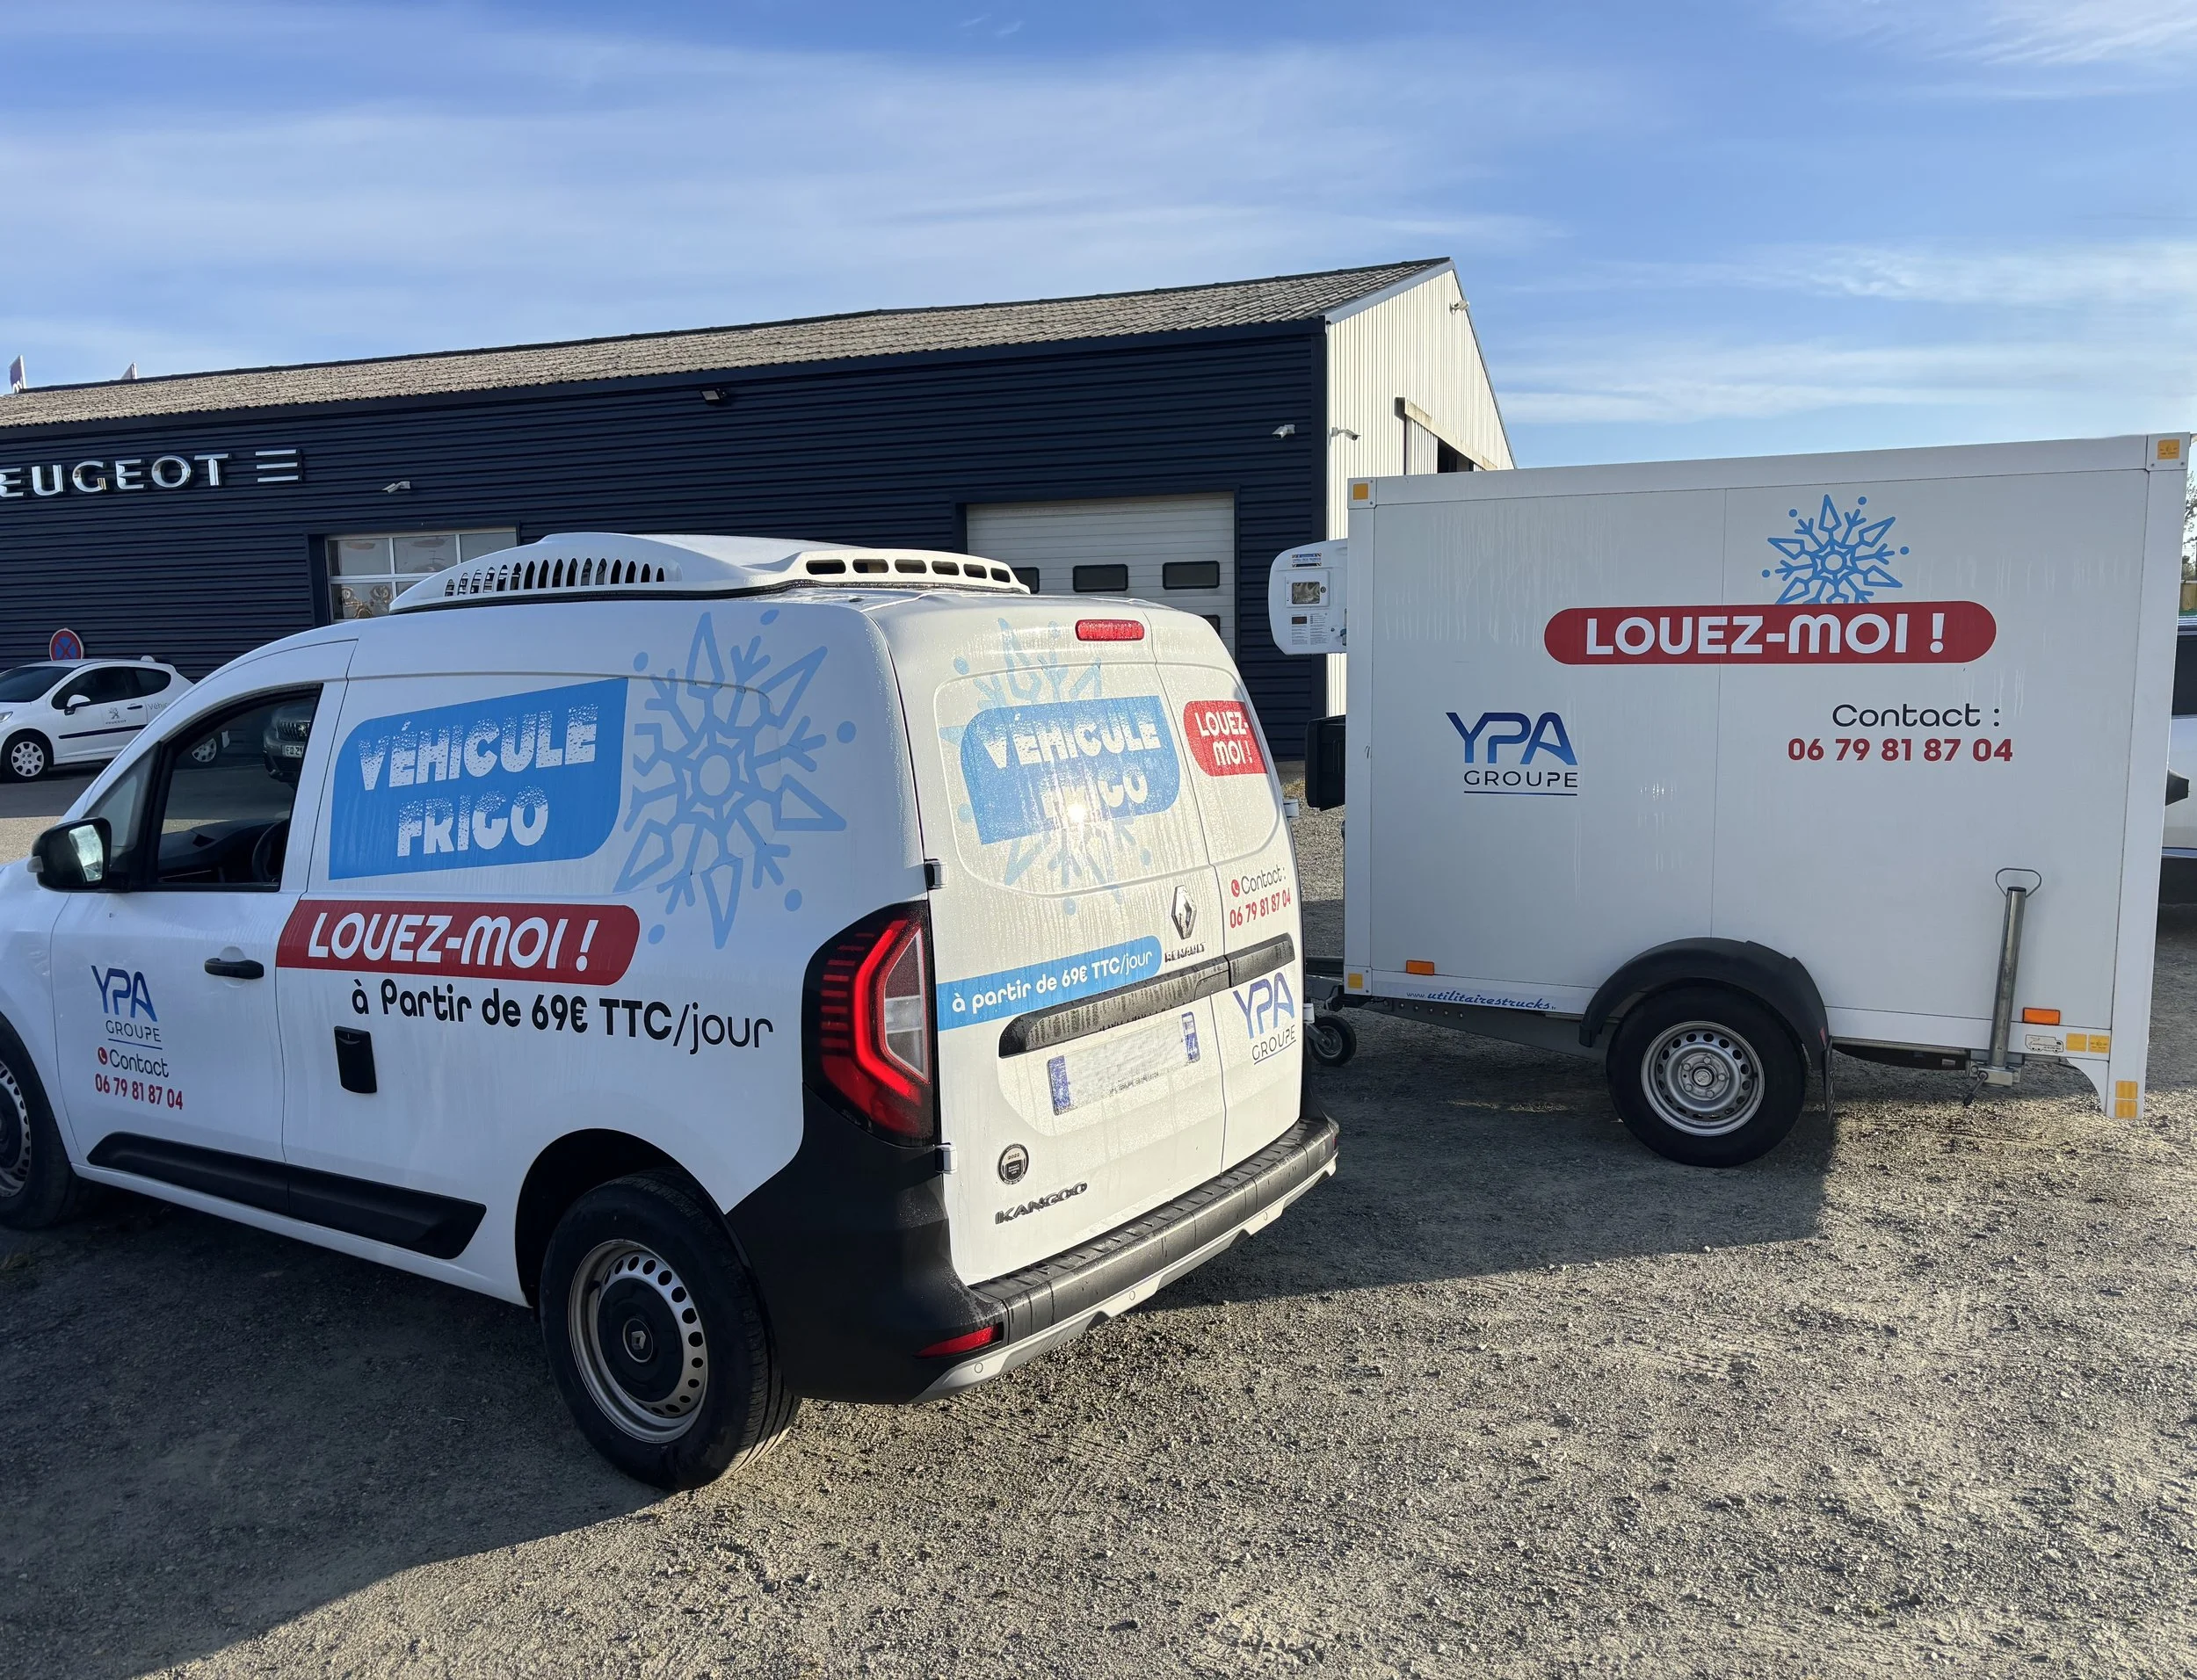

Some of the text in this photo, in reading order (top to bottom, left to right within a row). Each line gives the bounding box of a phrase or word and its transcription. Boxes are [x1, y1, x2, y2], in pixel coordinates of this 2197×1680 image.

[0, 453, 230, 498] EUGEOT
[1585, 612, 1945, 655] LOUEZ-MOI !
[1194, 711, 1249, 737] LOUEZ-
[1832, 703, 1981, 728] Contact
[358, 704, 598, 791] VÉHICULE
[981, 711, 1162, 770] VÉHICULE
[1213, 739, 1246, 765] MOI
[1446, 712, 1578, 765] YPA
[1787, 738, 2013, 762] 06 79 81 87 04
[1464, 771, 1577, 788] GROUPE
[397, 786, 548, 857] FRIGO
[1241, 865, 1282, 894] Contact
[1229, 887, 1291, 929] 06 79 81 87 04
[308, 912, 599, 972] LOUEZ-MOI !
[91, 965, 157, 1022] YPA
[952, 950, 1153, 1014] à partir de 69€ TTC/jour
[352, 978, 774, 1055] à Partir de 69€ TTC/jour
[1232, 972, 1295, 1039] YPA
[105, 1019, 161, 1042] GROUPE
[1251, 1025, 1295, 1061] GROUPE
[109, 1049, 170, 1078] Contact
[95, 1073, 183, 1110] 06 79 81 87 04
[995, 1181, 1088, 1225] KANGOO
